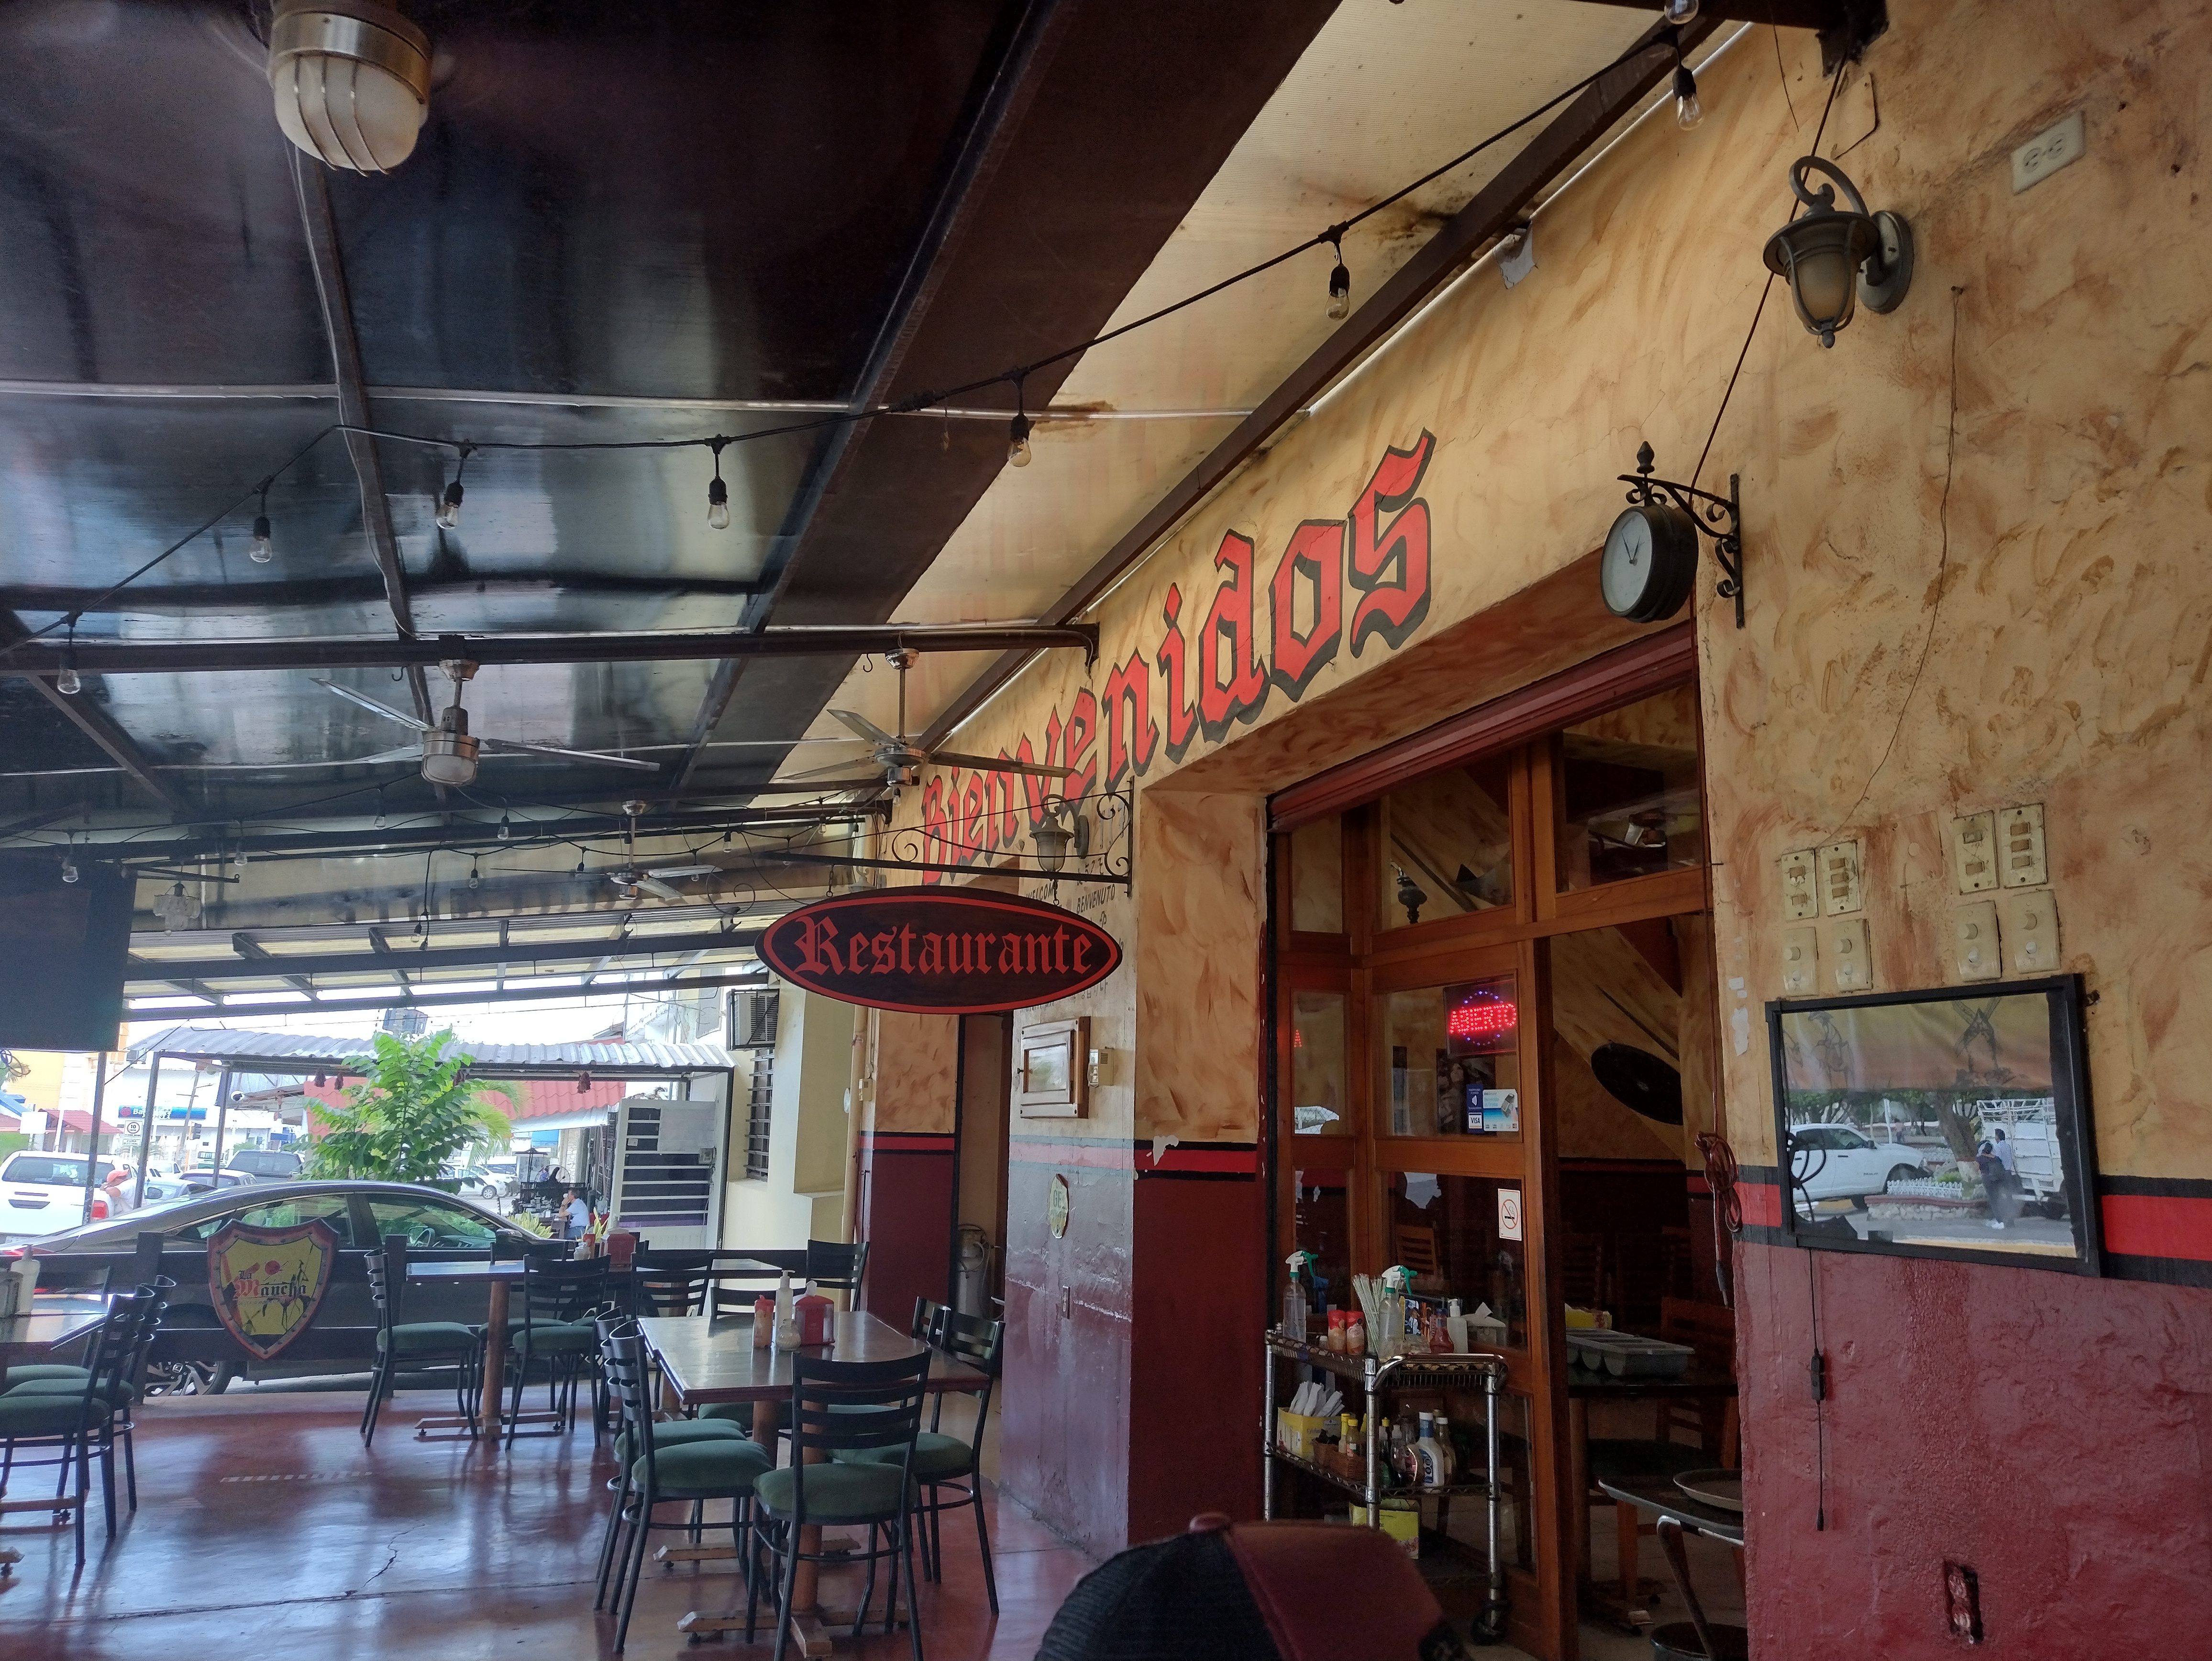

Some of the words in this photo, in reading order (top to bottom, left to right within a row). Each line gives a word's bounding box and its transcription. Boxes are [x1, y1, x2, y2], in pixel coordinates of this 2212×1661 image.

[922, 428, 1436, 886] Bienvenidos
[1076, 884, 1116, 914] BENVENUTO
[793, 915, 1092, 977] Restaurante
[1449, 1004, 1516, 1033] ABIERTO
[233, 1274, 307, 1297] Mancha
[238, 1270, 252, 1280] La
